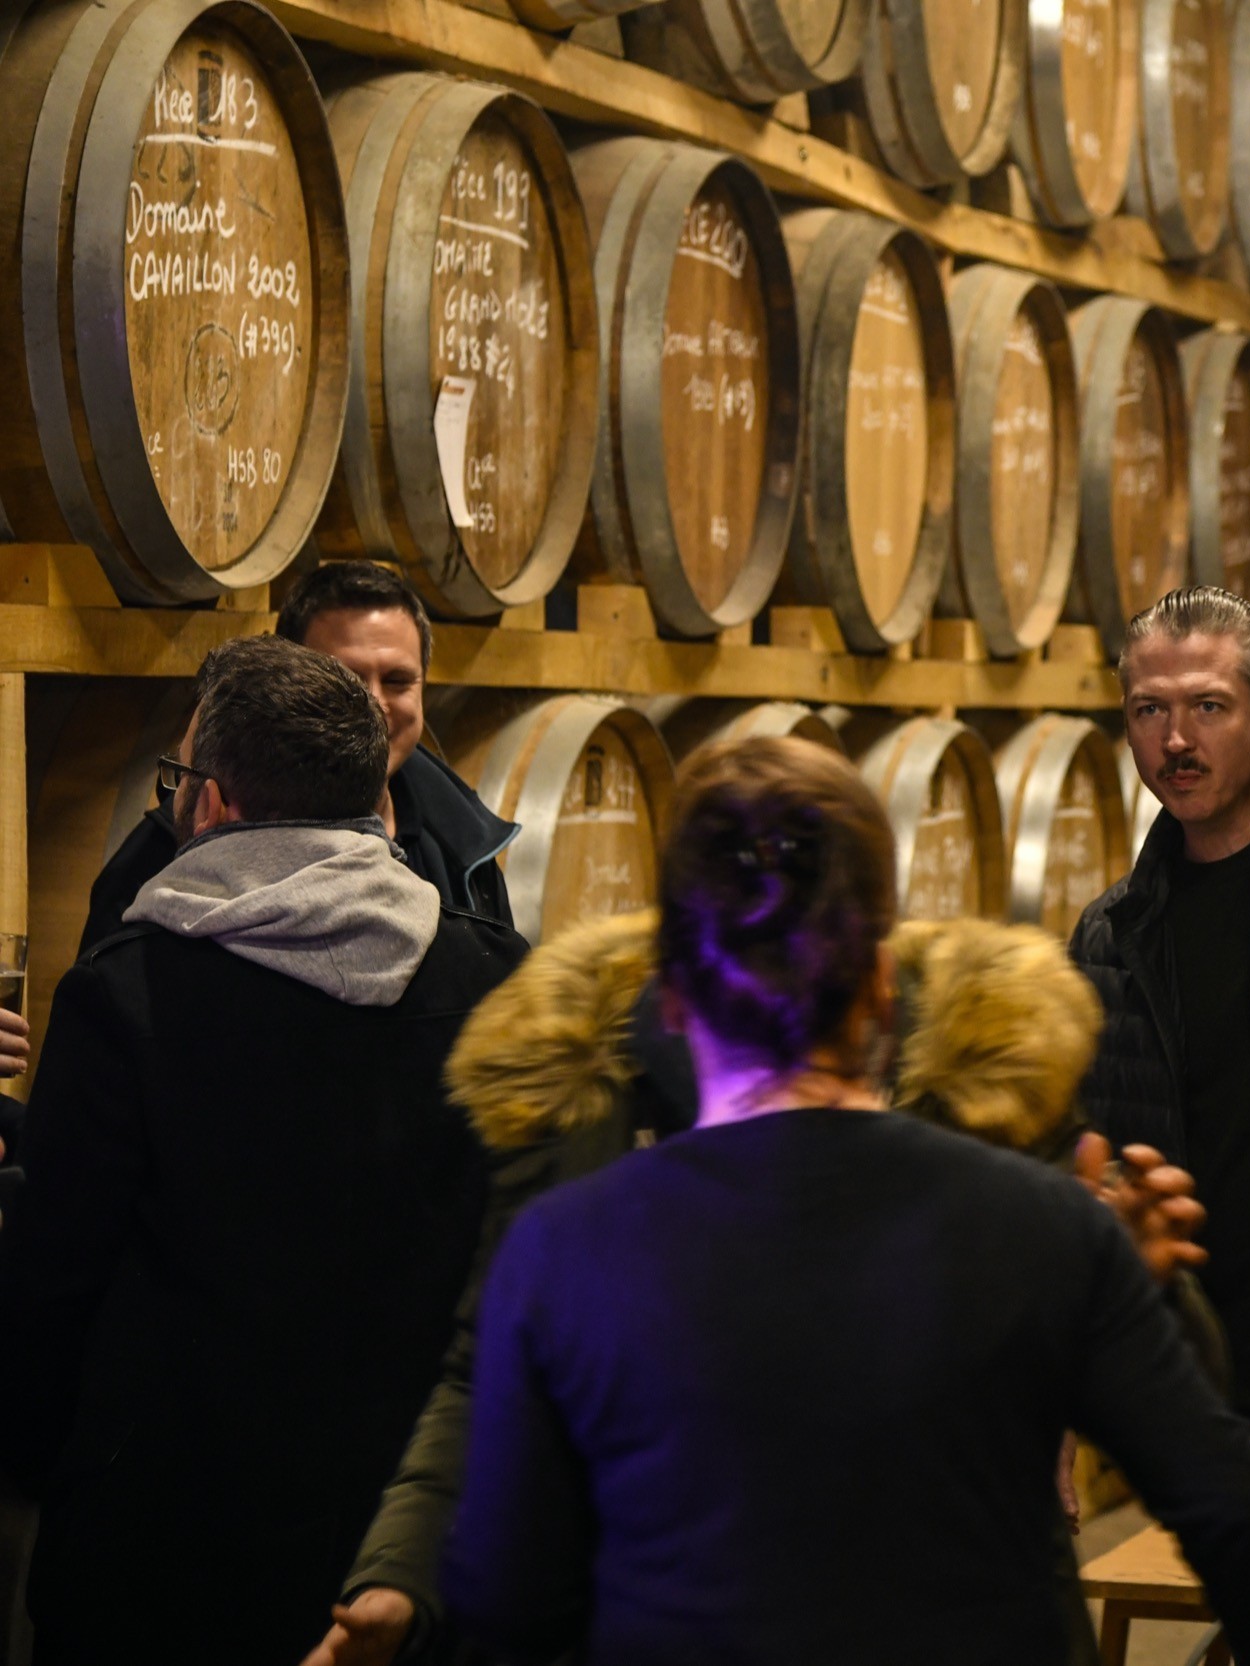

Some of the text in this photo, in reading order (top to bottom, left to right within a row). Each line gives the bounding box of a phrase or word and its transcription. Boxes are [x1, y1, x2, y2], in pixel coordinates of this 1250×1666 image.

[210, 71, 258, 130] 183
[126, 181, 236, 244] Domaine
[247, 254, 299, 308] 2002
[262, 448, 281, 485] 80
